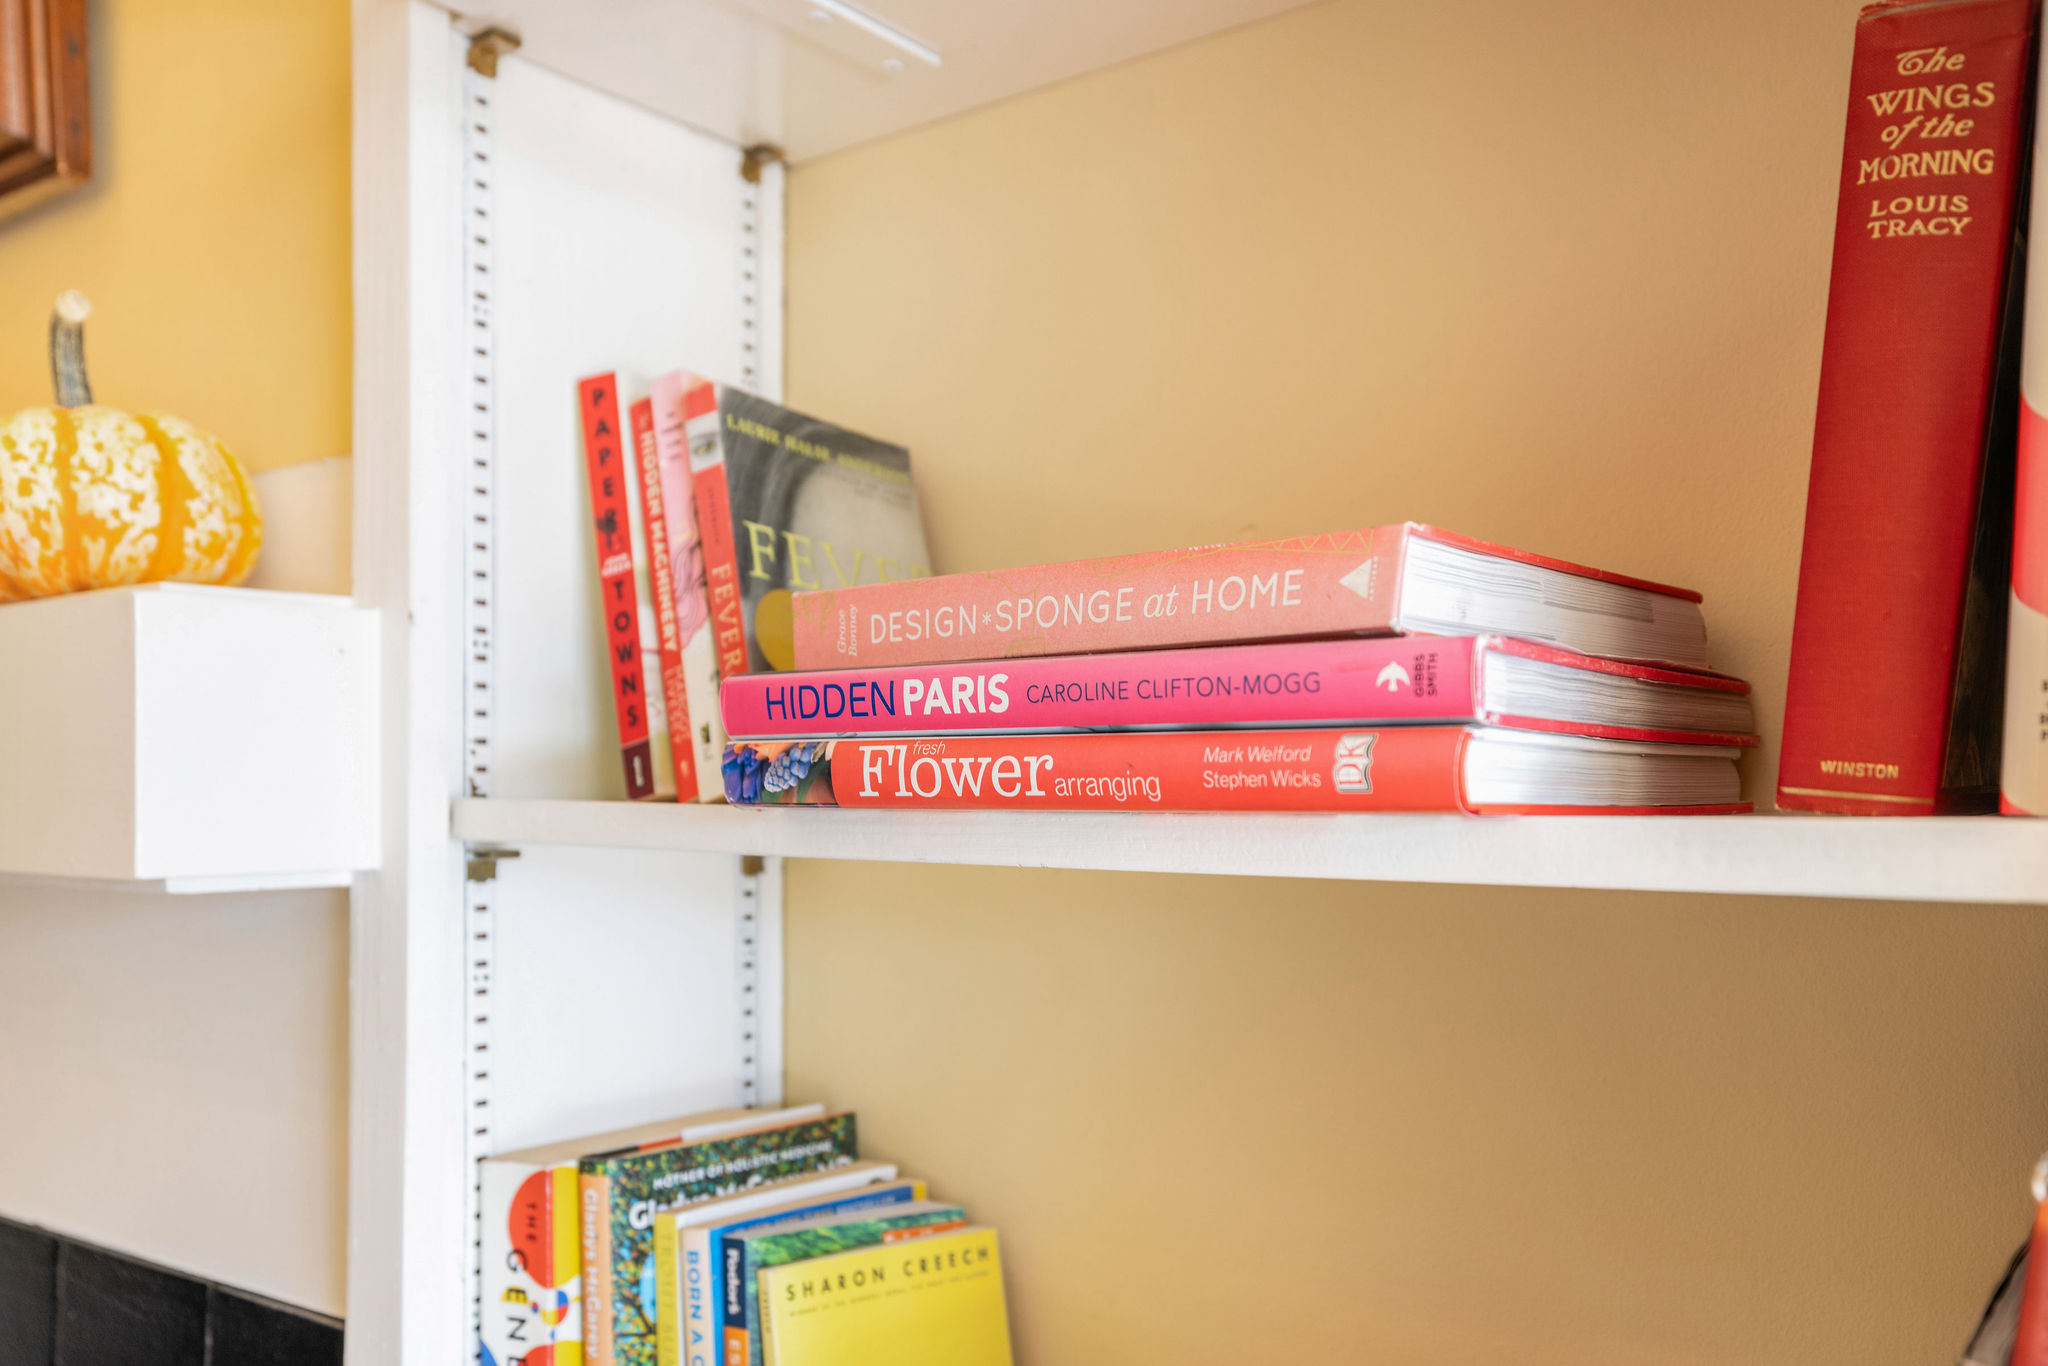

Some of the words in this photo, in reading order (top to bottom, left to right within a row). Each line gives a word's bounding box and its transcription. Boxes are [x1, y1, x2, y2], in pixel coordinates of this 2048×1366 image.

[1896, 46, 1966, 76] The
[1867, 81, 1996, 117] WINGS
[1881, 114, 1924, 150] of
[1920, 112, 1974, 139] the
[1856, 148, 1995, 185] MORNING
[1867, 216, 1972, 239] TRACY
[1869, 194, 1969, 218] LOUIS
[640, 430, 662, 515] HIDDEN
[650, 520, 678, 652] MACHINERY
[1143, 584, 1179, 619] at
[1191, 569, 1305, 615] HOME
[712, 563, 743, 671] FEVER
[837, 609, 847, 654] Grace
[848, 603, 859, 657] Bonney
[765, 680, 896, 721] HIDDEN
[903, 673, 1010, 716] PARIS
[1026, 680, 1129, 704] CAROLINE
[1137, 671, 1321, 700] CLIFTON-MOGG
[1414, 653, 1425, 698] GIBBS
[1427, 652, 1438, 697] SMITH
[912, 740, 946, 756] fresh
[1203, 746, 1244, 763] Mark
[1248, 744, 1313, 763] Welford
[1336, 736, 1372, 789] DK
[1820, 759, 1899, 780] WINSTON
[858, 744, 1054, 798] Flower
[1055, 770, 1162, 802] arranging
[1202, 769, 1267, 791] Stephen
[1270, 769, 1322, 788] Wicks
[652, 1167, 706, 1191] MOTHER
[585, 1188, 600, 1261] Gladys
[687, 1250, 703, 1320] BORN
[785, 1266, 885, 1302] SHARON
[902, 1247, 990, 1277] CREECH
[691, 1328, 704, 1347] A
